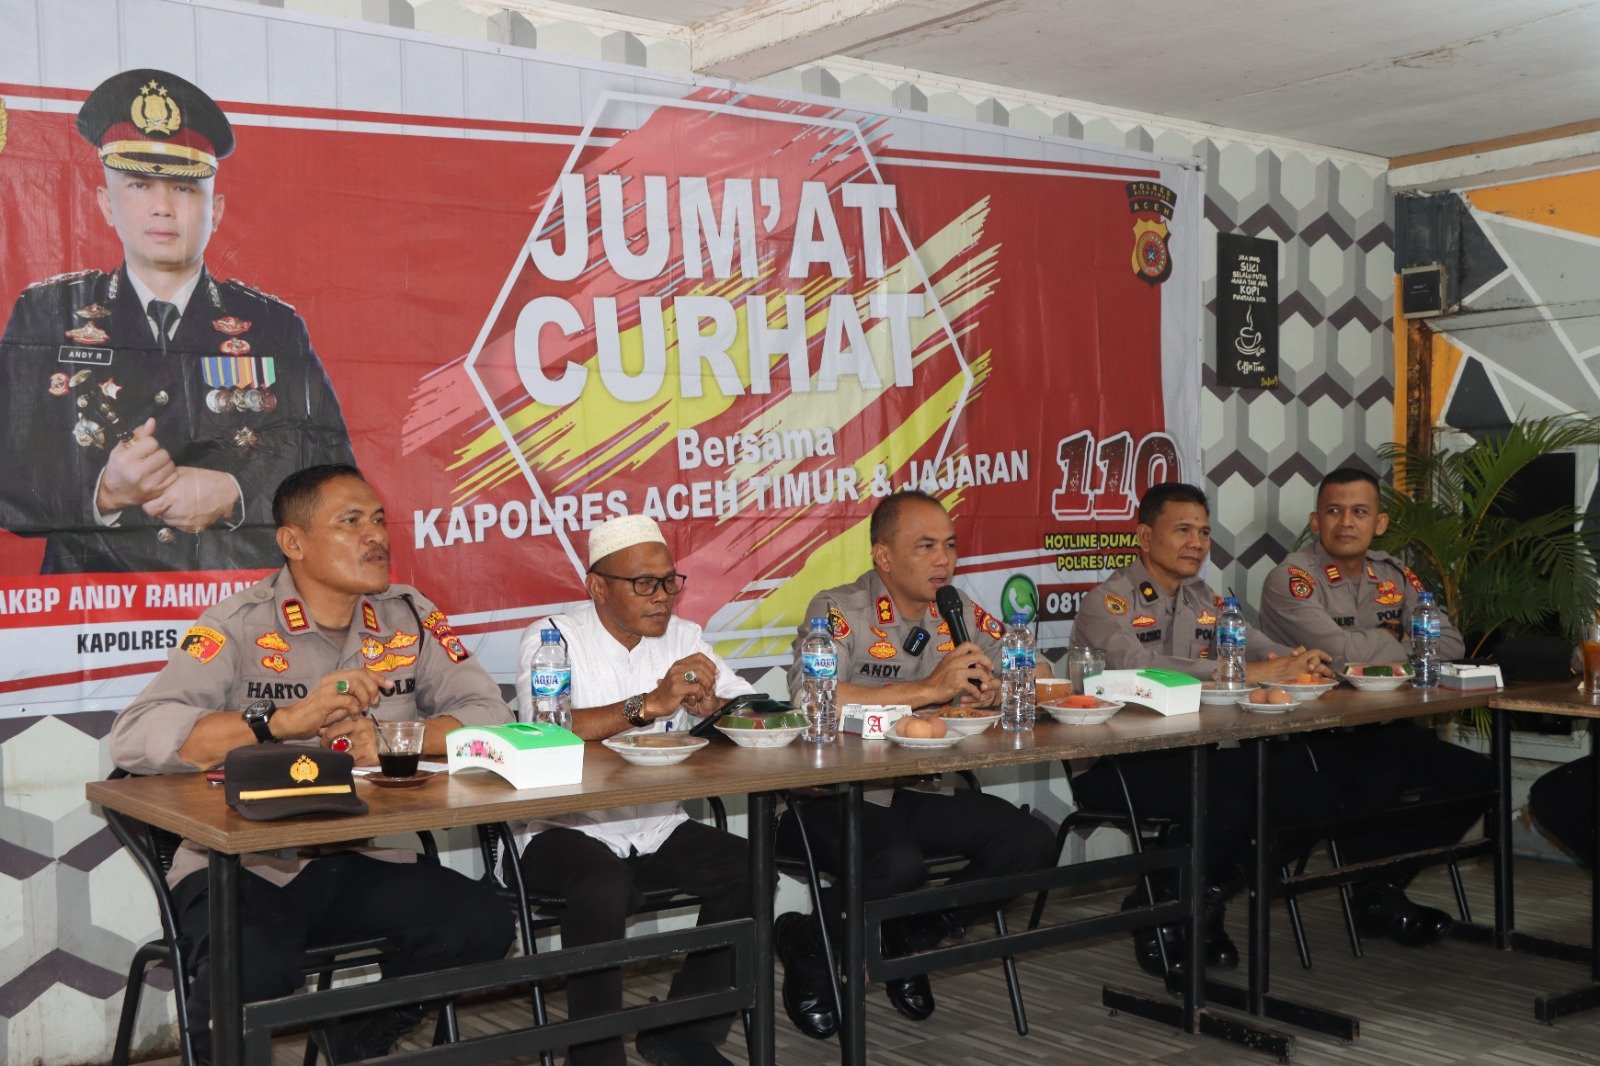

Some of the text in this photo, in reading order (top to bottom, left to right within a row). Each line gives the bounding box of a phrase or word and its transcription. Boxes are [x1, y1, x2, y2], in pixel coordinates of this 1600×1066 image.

[1132, 184, 1171, 197] POLRES
[1134, 202, 1170, 216] ACEH
[530, 173, 897, 281] JUM'AT
[1240, 262, 1259, 272] SUCI
[1240, 285, 1260, 296] KOPI
[69, 351, 103, 360] ANDY R
[514, 294, 924, 406] CURHAT
[677, 427, 835, 470] Bersama
[1052, 430, 1182, 520] 110
[413, 450, 1028, 550] KAPOLRES ACEH TIMUR & JAJARAN
[1044, 533, 1098, 549] HOTLINE
[1057, 554, 1137, 570] POLRES ACE
[69, 584, 138, 612] ANDY
[146, 580, 261, 609] RAHMA
[1046, 591, 1089, 614] 081
[77, 629, 178, 654] KAPOLRES
[813, 658, 835, 668] AQUA
[859, 662, 901, 679] ANDY
[533, 674, 559, 685] AQUA
[247, 681, 308, 699] HARTO
